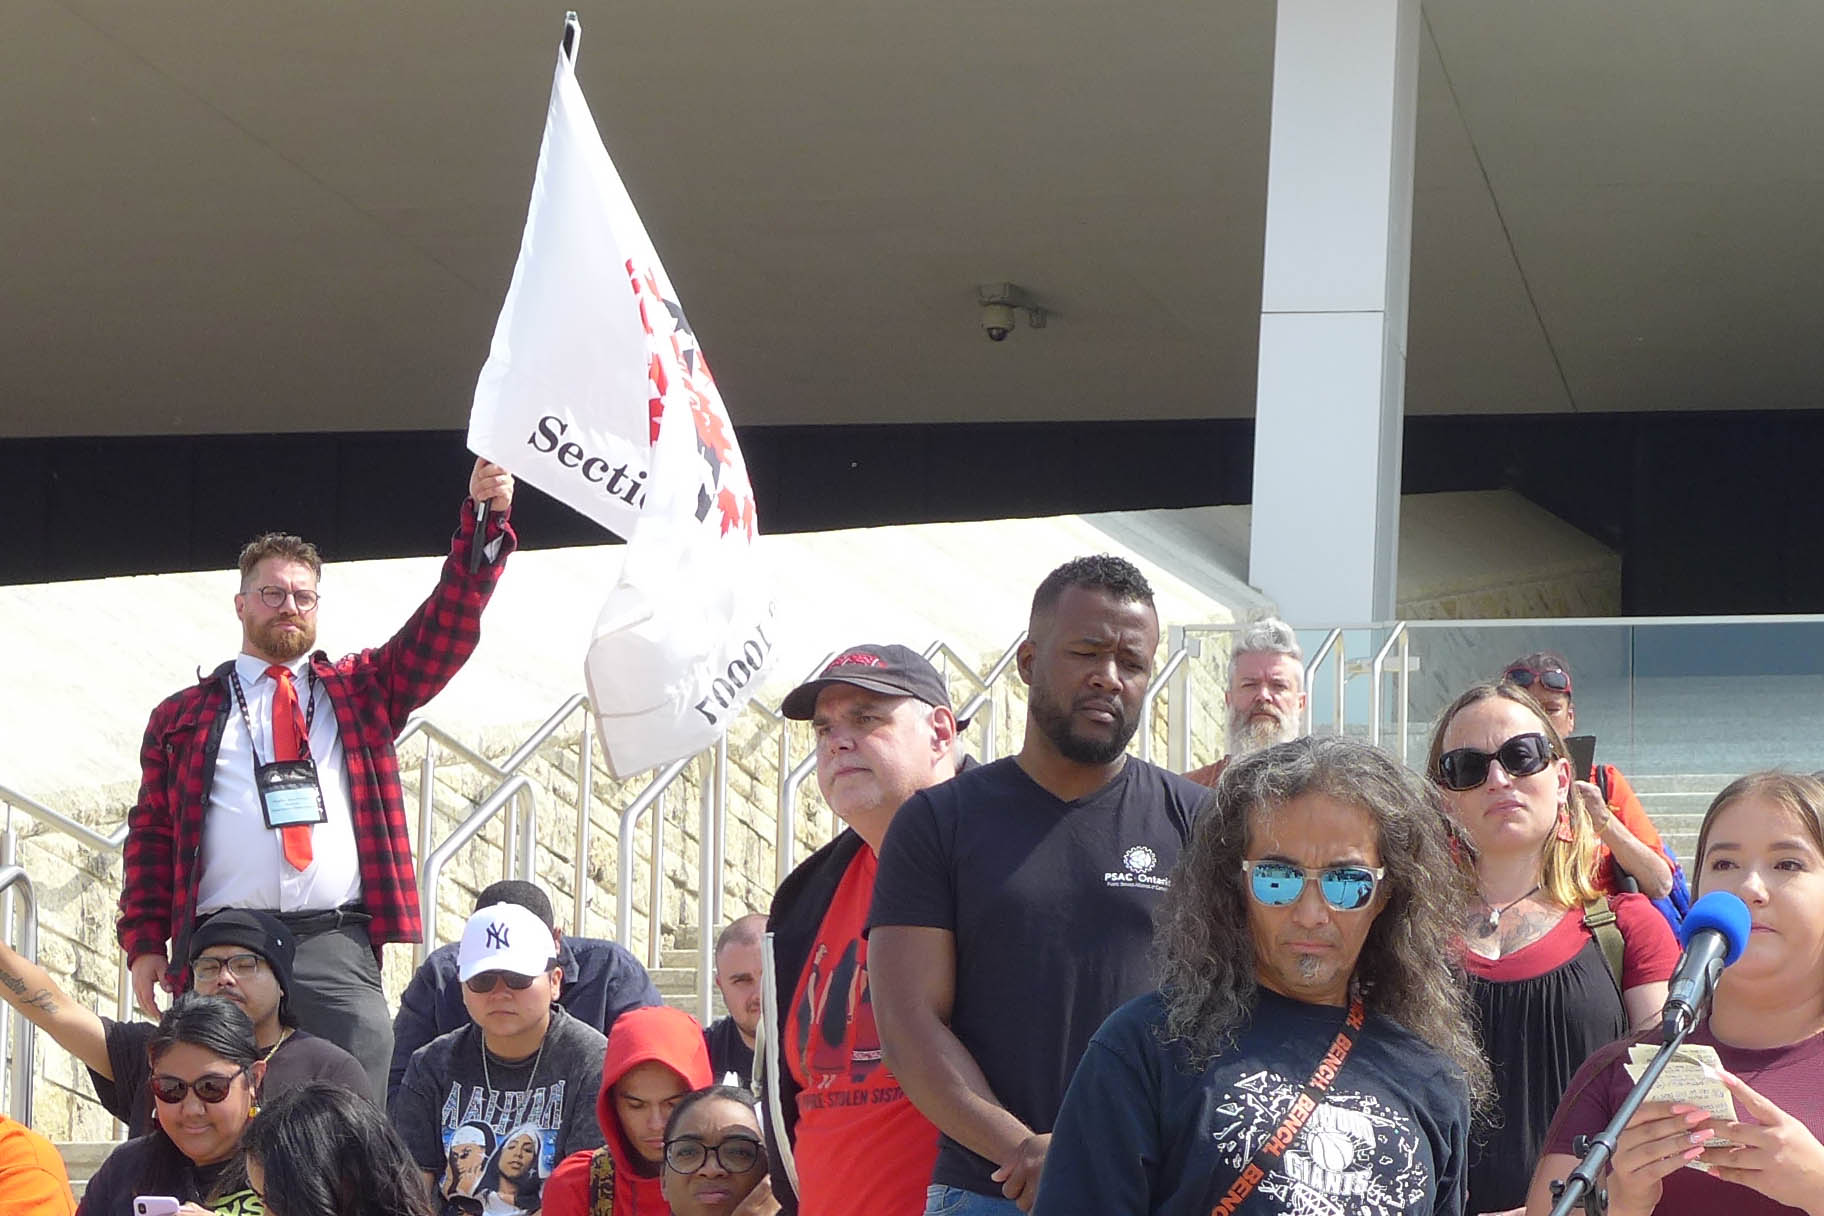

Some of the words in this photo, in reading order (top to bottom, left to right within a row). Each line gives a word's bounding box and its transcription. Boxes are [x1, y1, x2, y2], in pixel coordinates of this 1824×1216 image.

[527, 416, 647, 510] Secti
[1104, 872, 1133, 882] PSAC
[486, 922, 510, 950] NY
